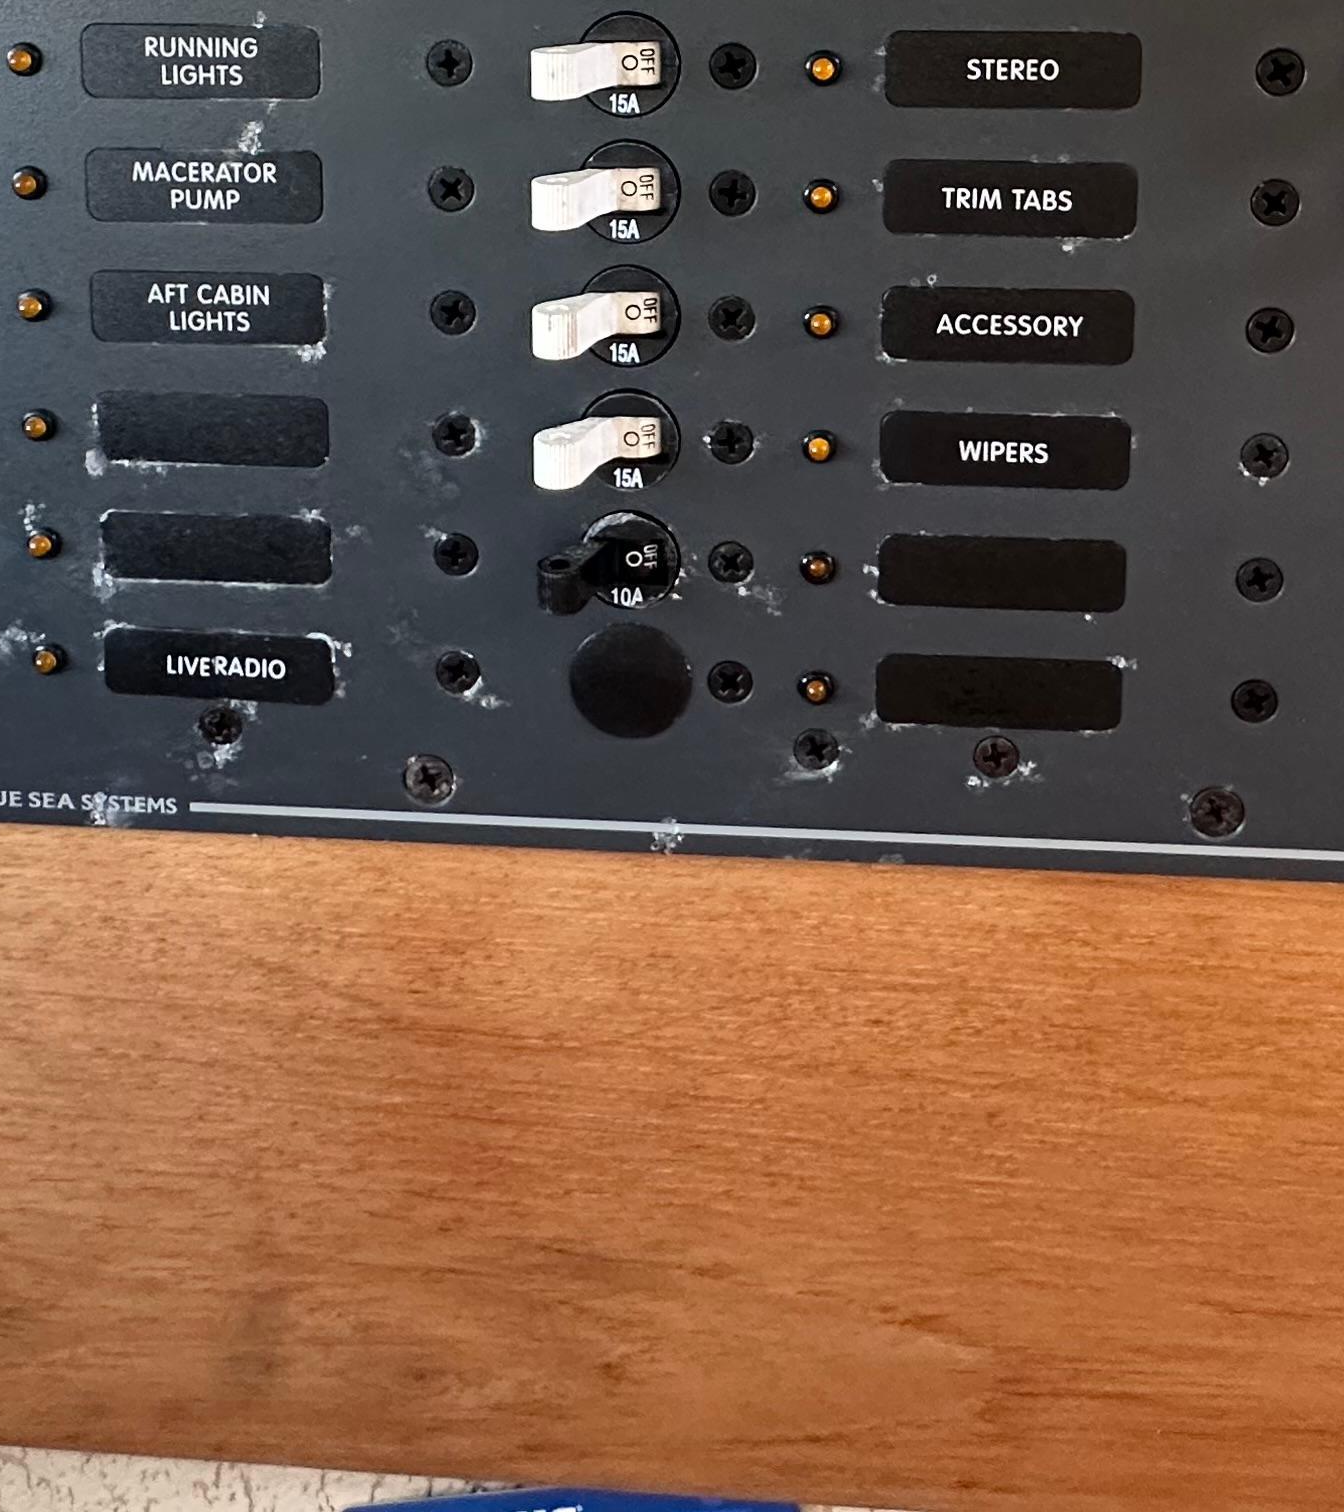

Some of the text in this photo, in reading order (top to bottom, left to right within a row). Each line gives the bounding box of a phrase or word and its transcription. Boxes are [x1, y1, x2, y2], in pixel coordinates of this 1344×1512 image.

[144, 37, 258, 58] RUNNING
[640, 49, 655, 75] OFF
[967, 59, 1059, 81] STEREO
[161, 64, 243, 86] LIGHTS
[609, 94, 639, 113] 15A
[132, 161, 277, 184] MACERATOR
[640, 175, 655, 200] OFF
[170, 189, 240, 210] PUMP
[942, 188, 1072, 211] TRIM TABS
[609, 219, 639, 239] 15A
[147, 284, 270, 305] AFT CABIN
[169, 310, 250, 332] LIGHTS
[643, 298, 657, 323] OFF
[936, 314, 1083, 337] ACCESSORY
[609, 344, 639, 363] 15A
[640, 424, 655, 450] OFF
[959, 441, 1048, 464] WIPERS
[613, 469, 643, 488] 15A
[642, 545, 657, 569] OFF
[610, 587, 643, 607] 10A
[28, 791, 75, 810] SEA
[81, 792, 177, 814] SYSTEMS
